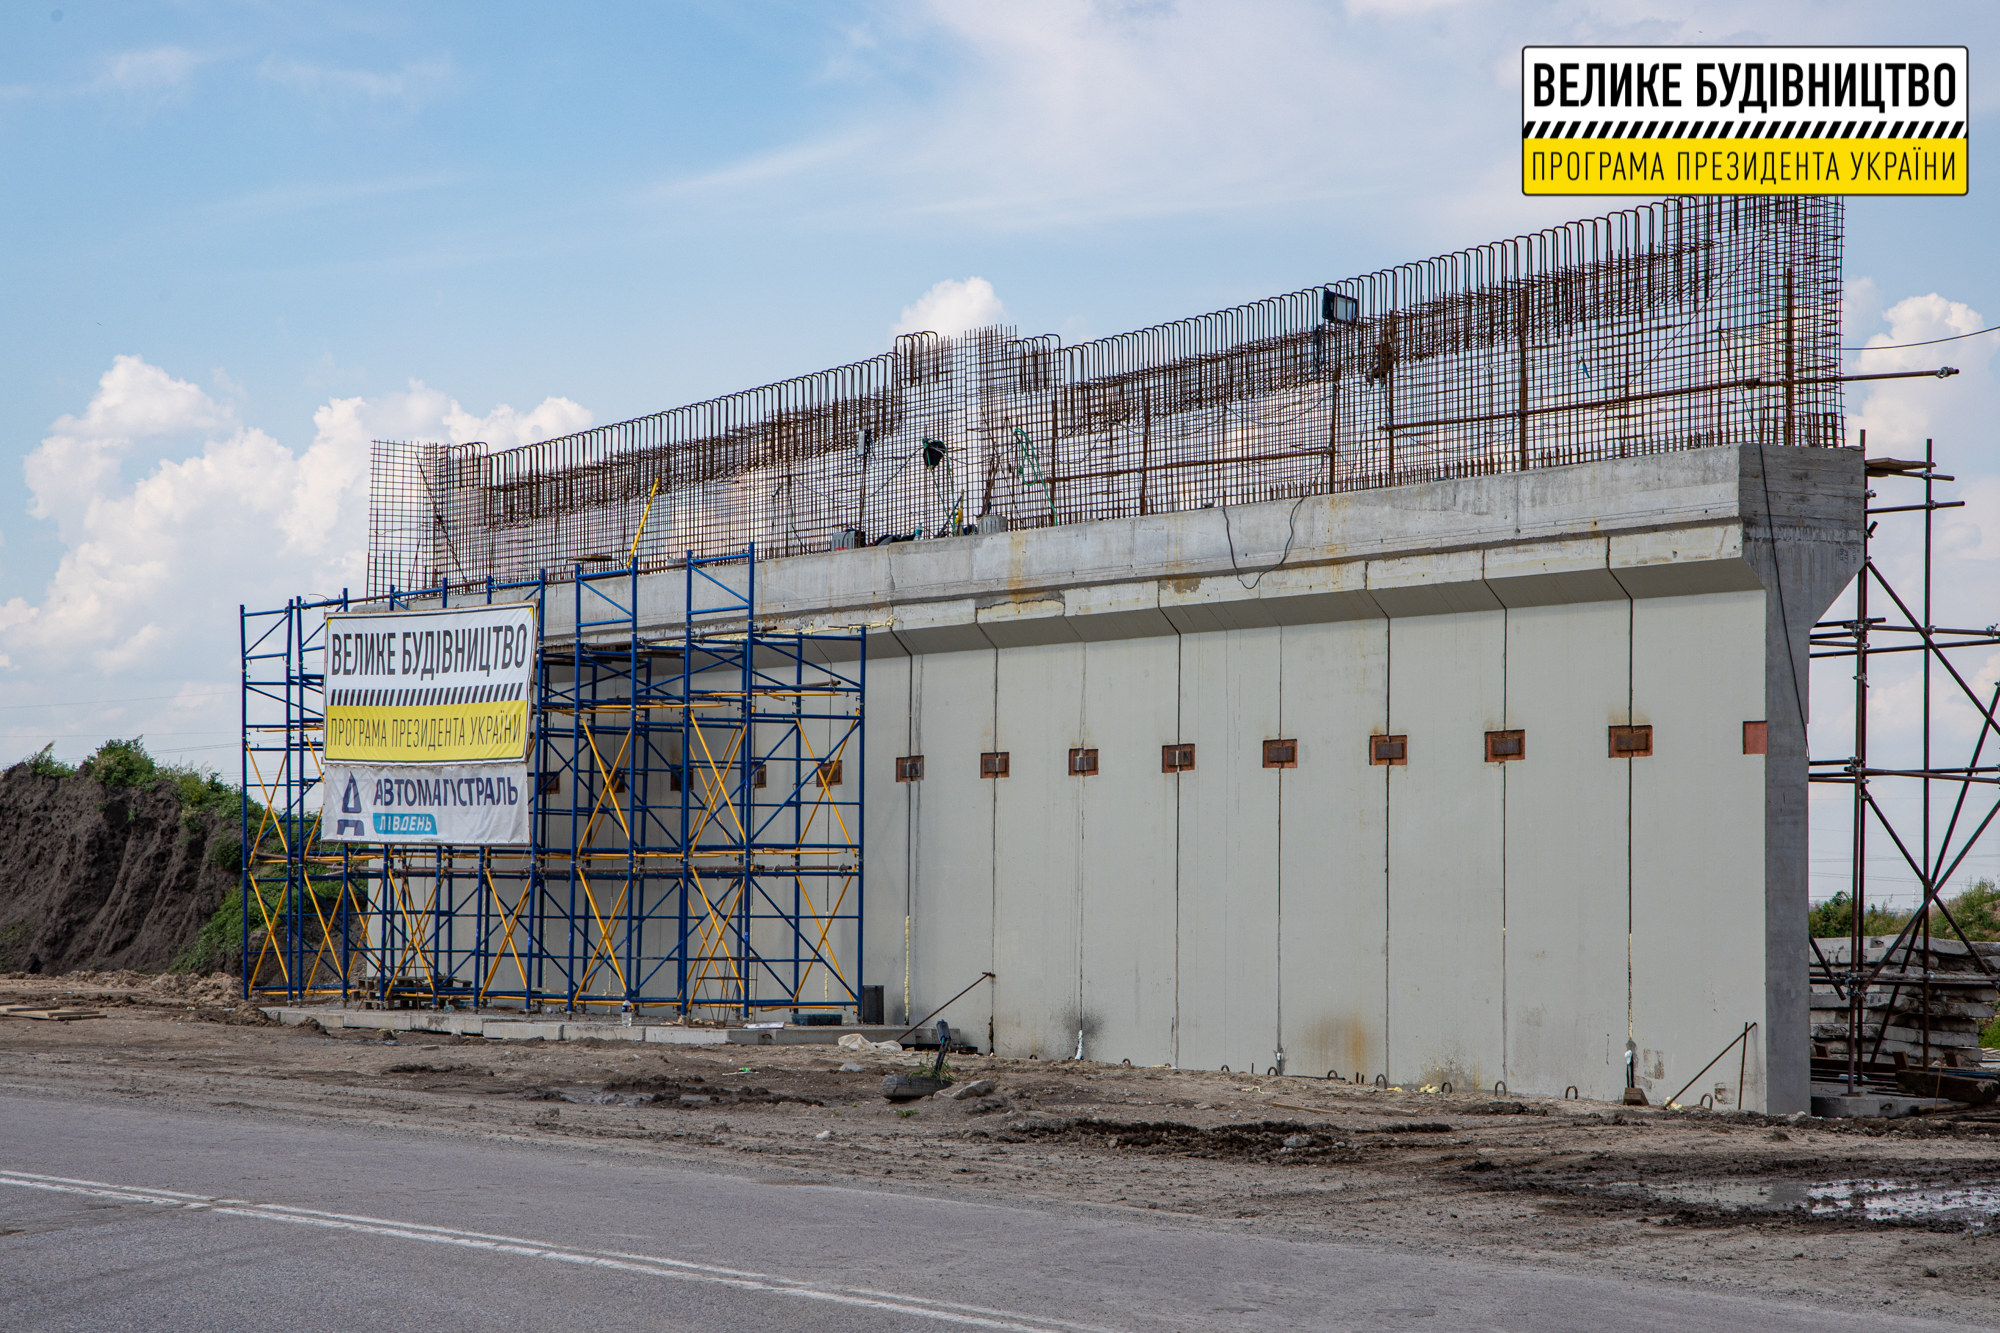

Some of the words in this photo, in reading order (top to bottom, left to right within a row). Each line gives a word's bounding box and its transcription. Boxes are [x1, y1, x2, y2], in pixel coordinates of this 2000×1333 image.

[331, 632, 396, 676] ВЕЛИКЕ
[401, 623, 528, 681] БУДІВНИЦТВО
[330, 718, 387, 747] ПРОГРАМА
[391, 717, 466, 751] ПРЕЗИДЕНТА
[469, 710, 522, 746] УКРАЇНИ
